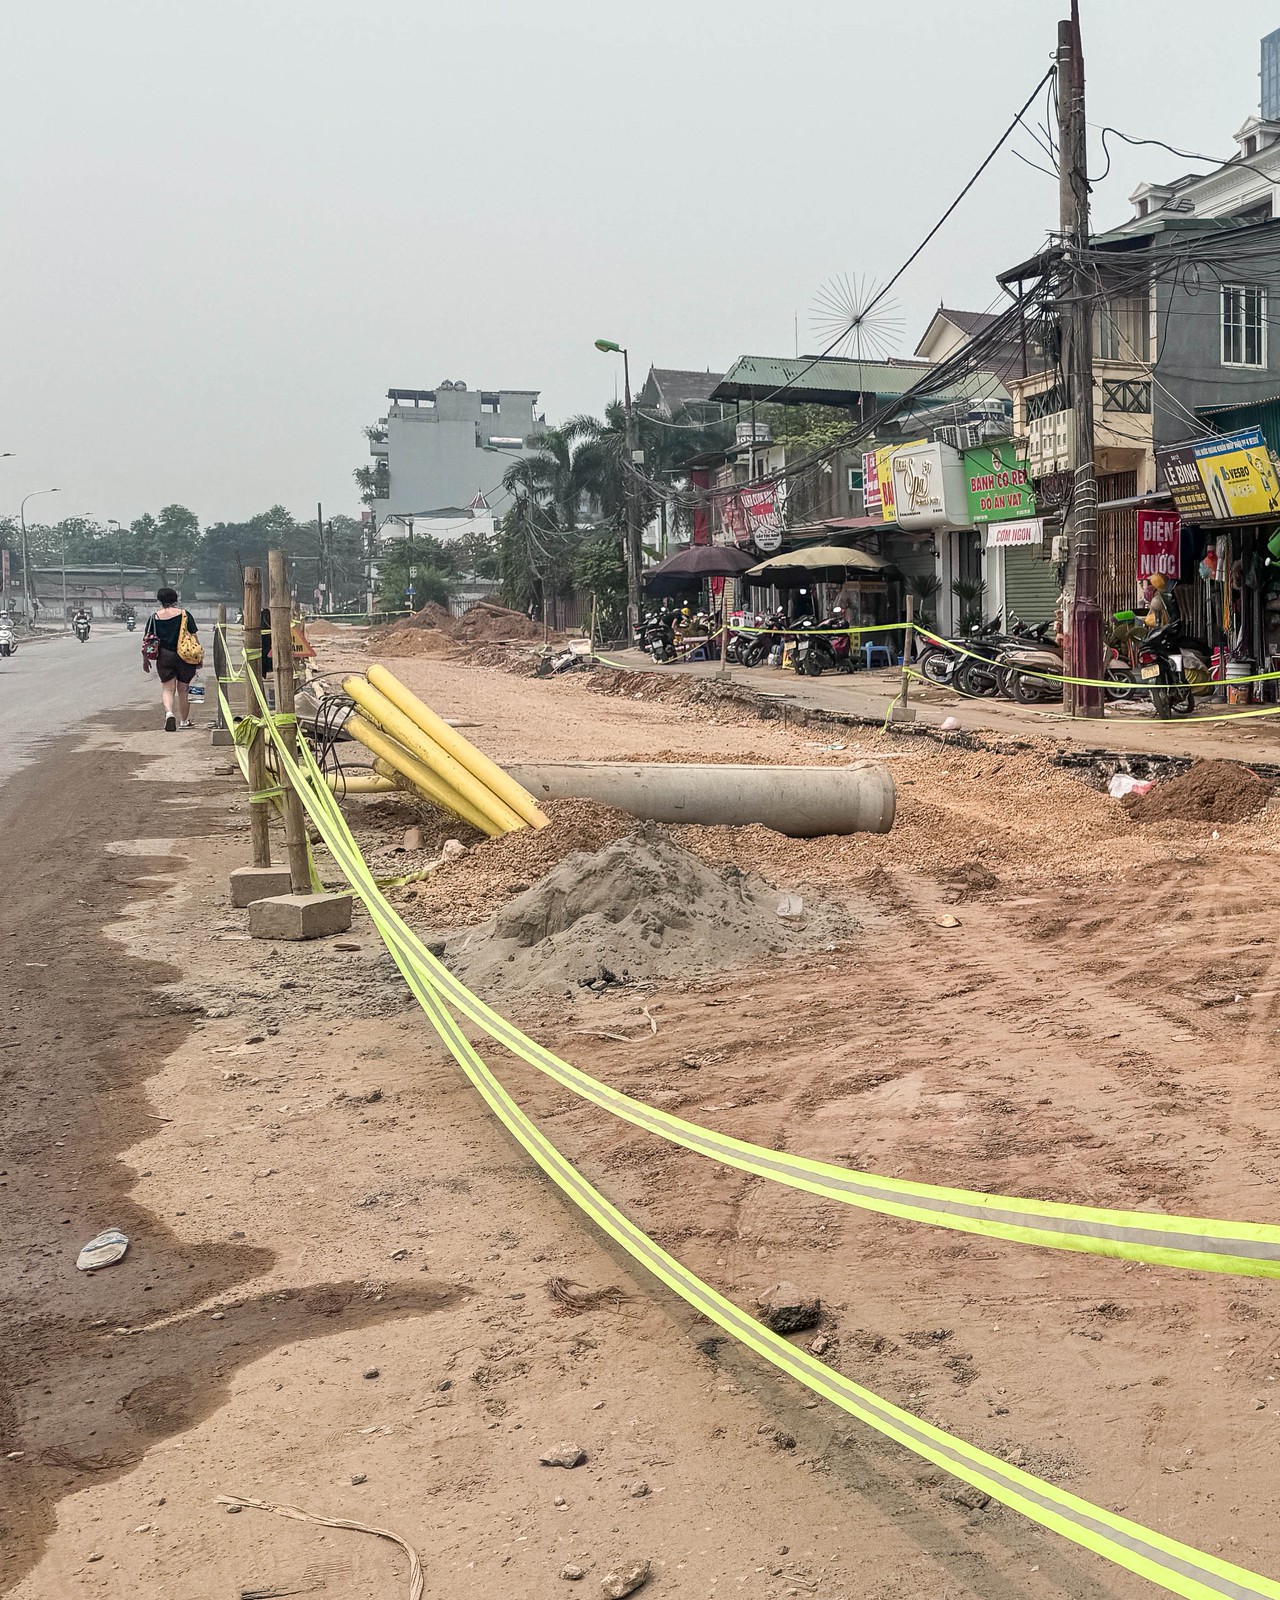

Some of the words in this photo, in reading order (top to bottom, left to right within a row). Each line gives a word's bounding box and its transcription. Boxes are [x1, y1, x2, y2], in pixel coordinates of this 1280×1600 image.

[970, 473, 995, 493] BÁNH
[1164, 462, 1176, 486] LÊ
[1176, 460, 1200, 483] BÌNH
[1229, 466, 1250, 480] VESBO
[1012, 527, 1032, 542] NGON
[1143, 517, 1175, 547] ĐIỆN
[1140, 549, 1176, 575] NƯỚC
